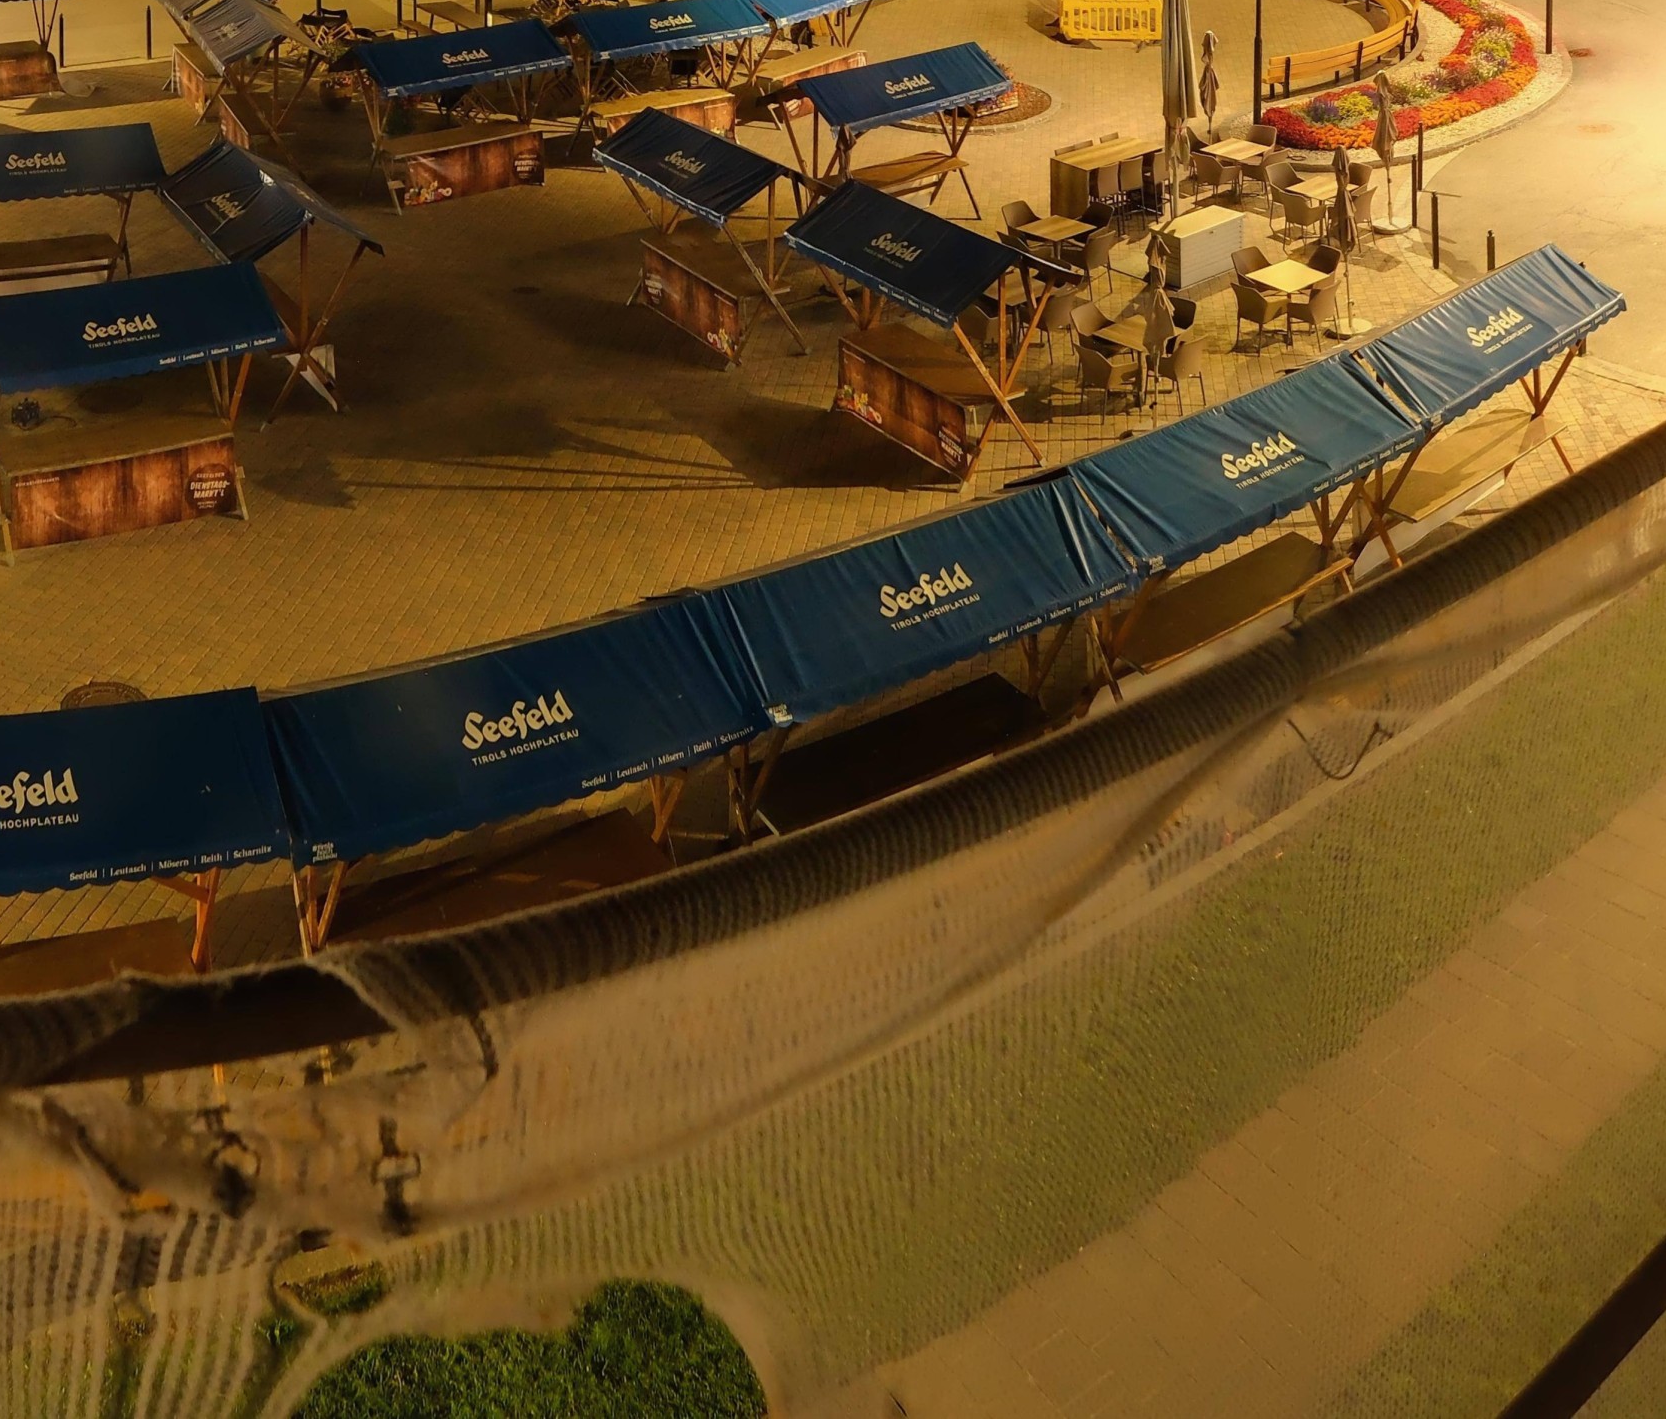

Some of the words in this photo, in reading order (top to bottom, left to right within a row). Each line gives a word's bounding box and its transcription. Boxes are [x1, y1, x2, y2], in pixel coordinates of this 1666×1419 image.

[649, 13, 693, 31] Seefeld
[442, 48, 489, 65] Seefeld
[885, 73, 931, 95] Seefeld
[5, 150, 66, 169] Seefeld
[664, 150, 707, 176] Seefeld
[870, 232, 924, 264] Seefeld
[82, 313, 158, 342] Seefeld
[1466, 306, 1525, 348] Seefeld
[1221, 431, 1297, 480] Seefeld
[1236, 475, 1260, 491] TIROLS
[1260, 454, 1306, 480] HOCHPLATEAU
[878, 561, 975, 619] Seefeld
[890, 614, 922, 632] TIROLS
[923, 593, 981, 621] HOCHPLATEAU
[461, 688, 575, 751] Seefeld
[471, 749, 507, 767] TIROLS
[509, 728, 581, 757] HOCHPLATEAU
[0, 812, 81, 831] HOCHPLATEAU
[69, 868, 99, 883] Seefeld
[109, 861, 148, 878] Leutasch
[200, 851, 223, 864] Reith
[233, 843, 273, 859] Scharnitz
